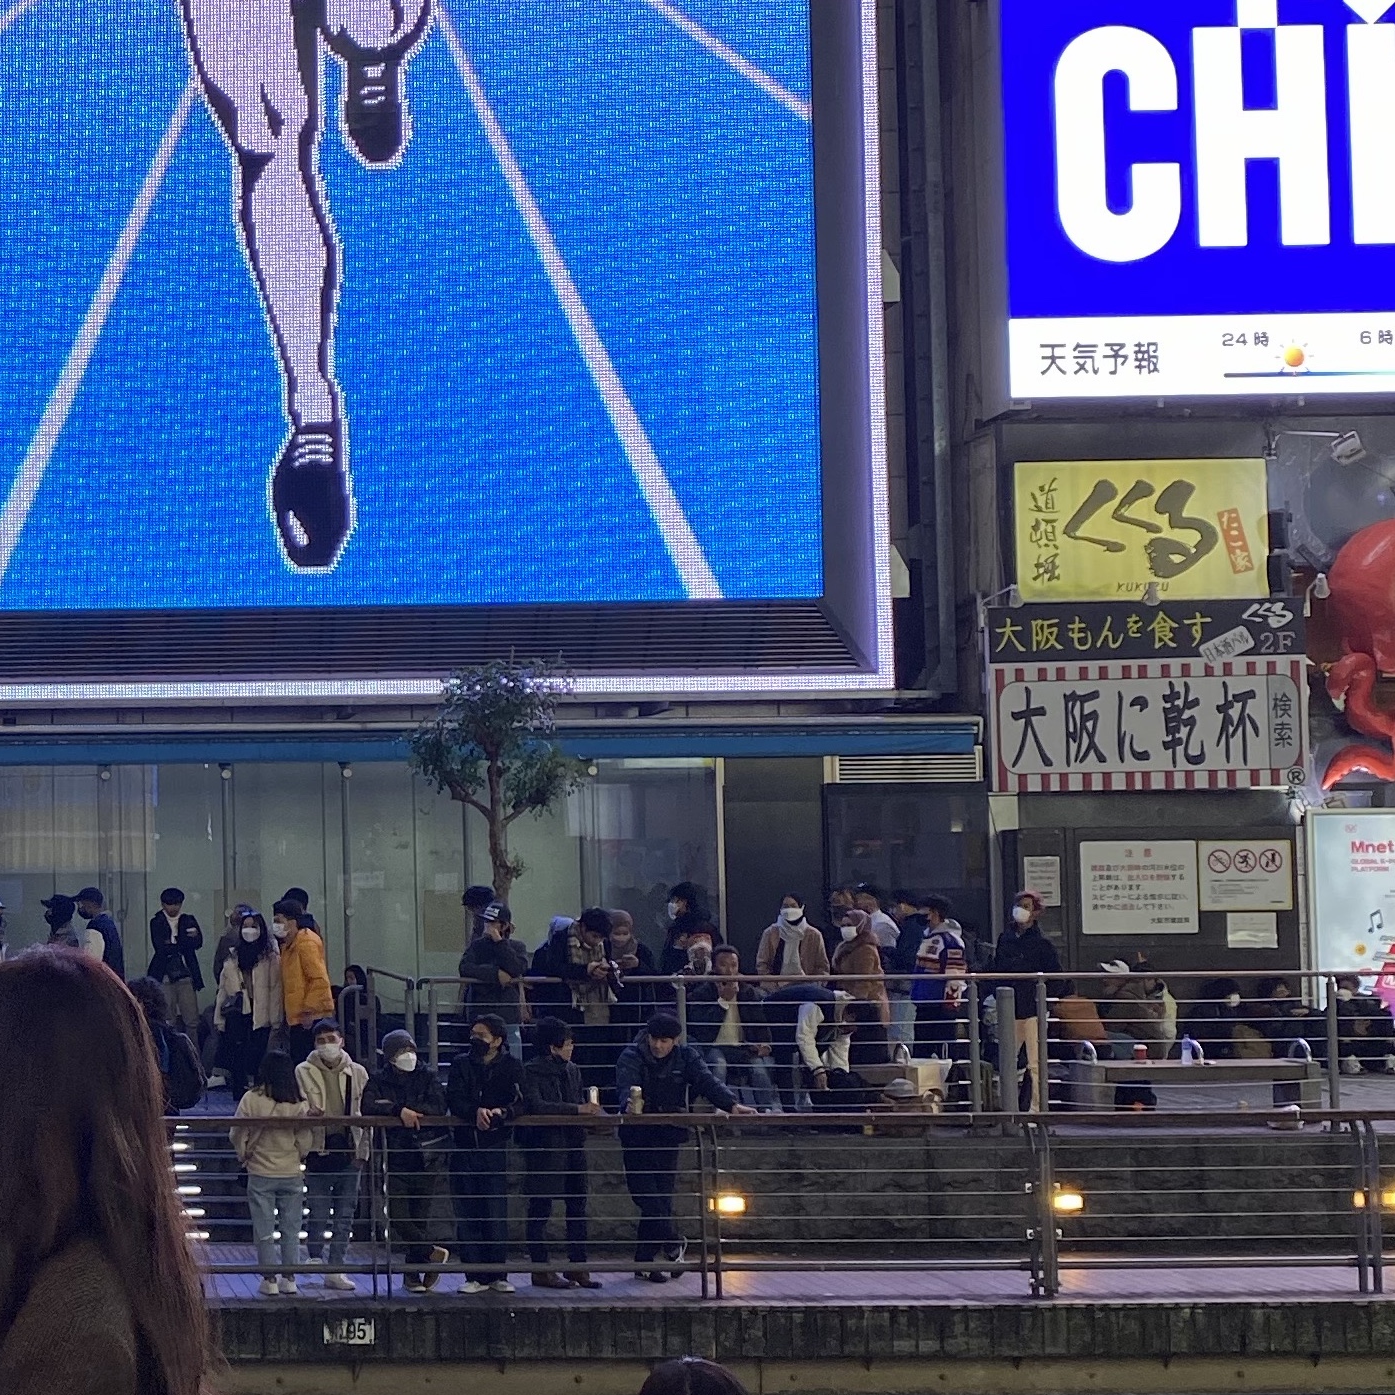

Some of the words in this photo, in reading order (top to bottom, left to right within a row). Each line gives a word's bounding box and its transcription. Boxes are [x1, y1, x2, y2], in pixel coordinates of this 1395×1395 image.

[1039, 341, 1160, 375] 天気予報
[1062, 478, 1219, 579] くくる
[995, 609, 1213, 653] 大阪もんを食す
[1259, 631, 1296, 653] 2F
[1010, 680, 1260, 769] 大阪に乾杯
[1271, 691, 1294, 749] 検索
[1350, 841, 1395, 854] Mnet
